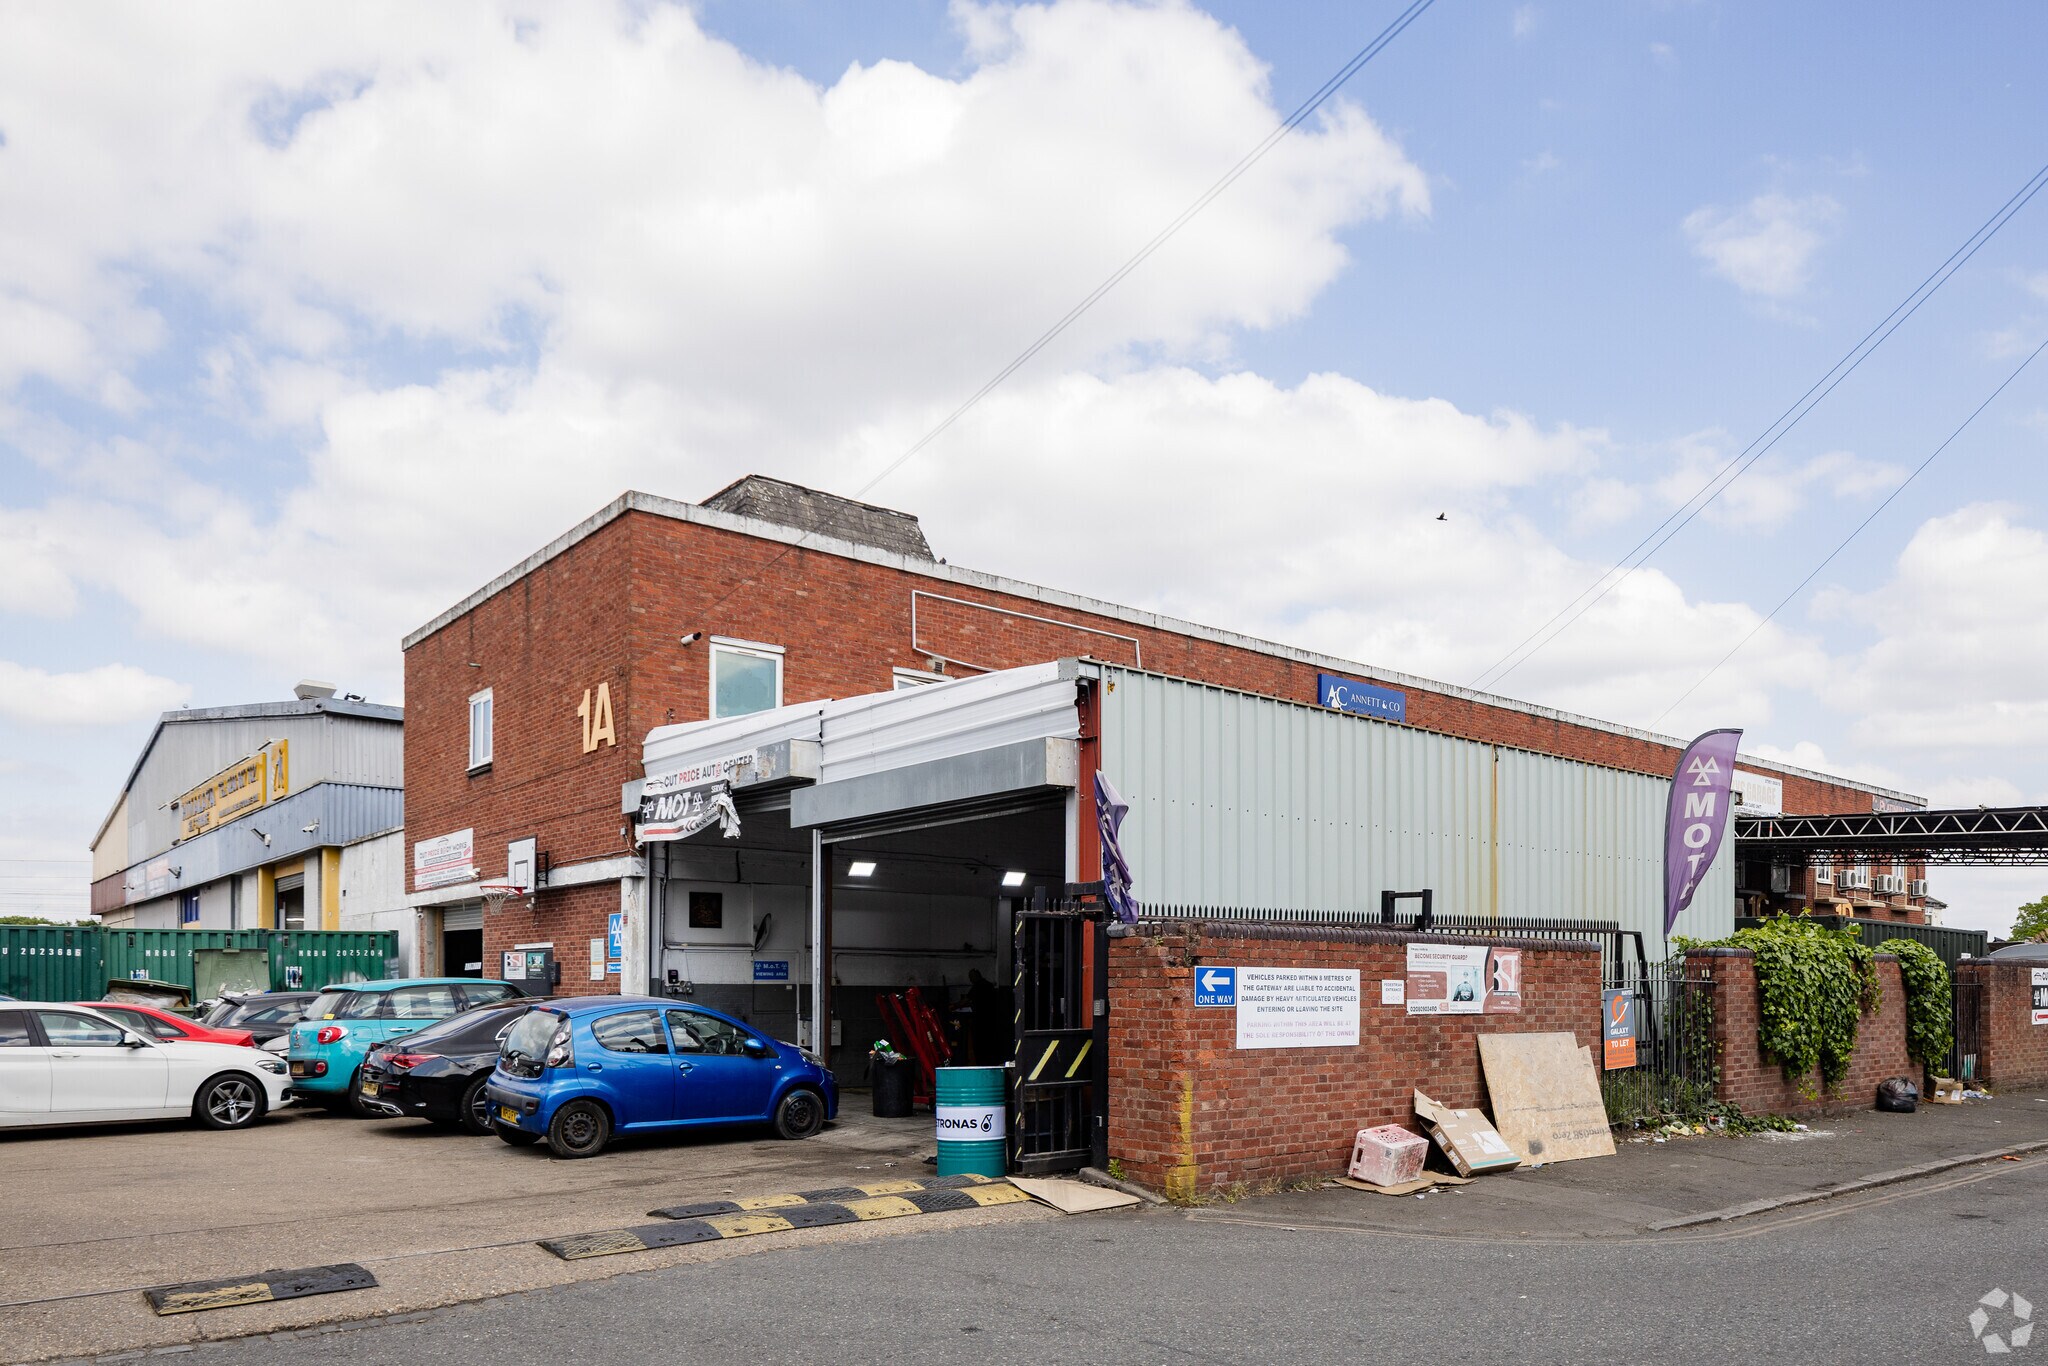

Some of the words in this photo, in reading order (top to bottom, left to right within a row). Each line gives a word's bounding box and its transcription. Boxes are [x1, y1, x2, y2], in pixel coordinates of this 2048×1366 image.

[1350, 693, 1380, 708] ANNETT
[1382, 700, 1388, 710] &
[1389, 701, 1400, 713] CO
[577, 681, 616, 754] 1A
[664, 774, 678, 787] CUT
[679, 768, 700, 784] PRICE
[1747, 782, 1776, 806] GARAGE
[654, 791, 691, 820] MOT
[1676, 792, 1717, 884] MOT
[145, 949, 176, 957] MRBU
[299, 949, 327, 957] MRBU
[1198, 995, 1215, 1004] ONE
[1217, 994, 1233, 1004] WAY
[1610, 1027, 1629, 1036] GALAXY
[1611, 1040, 1619, 1048] TO
[1619, 1039, 1629, 1047] LET
